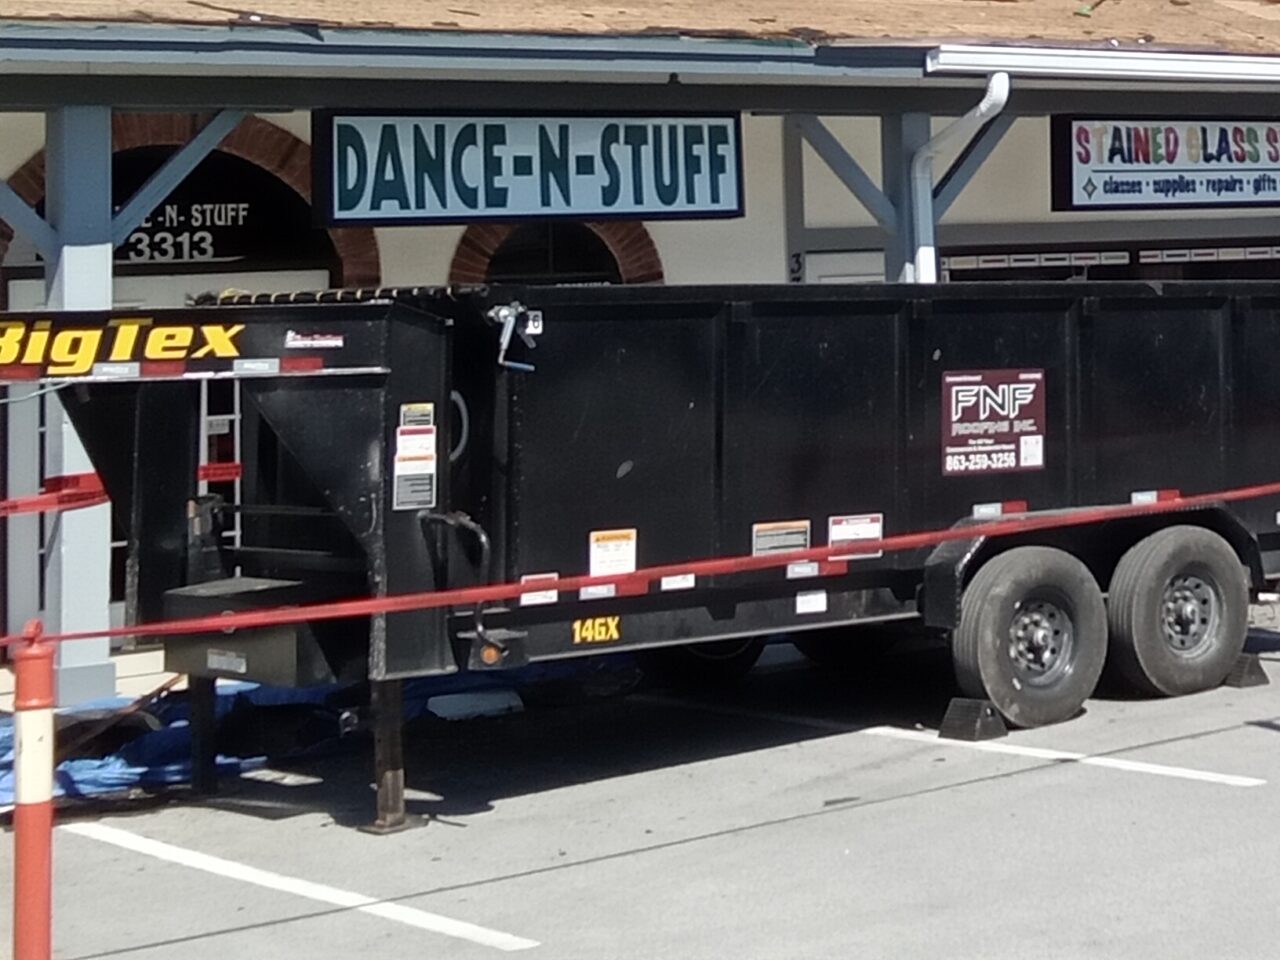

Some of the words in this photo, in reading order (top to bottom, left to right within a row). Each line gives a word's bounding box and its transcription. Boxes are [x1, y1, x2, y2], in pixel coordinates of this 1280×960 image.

[1076, 125, 1179, 165] STAINED
[1186, 126, 1260, 164] GLASS
[336, 123, 730, 211] DANCE-N-STUFF
[1103, 175, 1142, 194] classes
[1153, 174, 1197, 197] supplies
[1206, 175, 1244, 196] repairs
[1253, 174, 1277, 195] gifts
[191, 203, 249, 227] STUFF
[128, 231, 214, 261] 3313
[951, 383, 1037, 422] FNF
